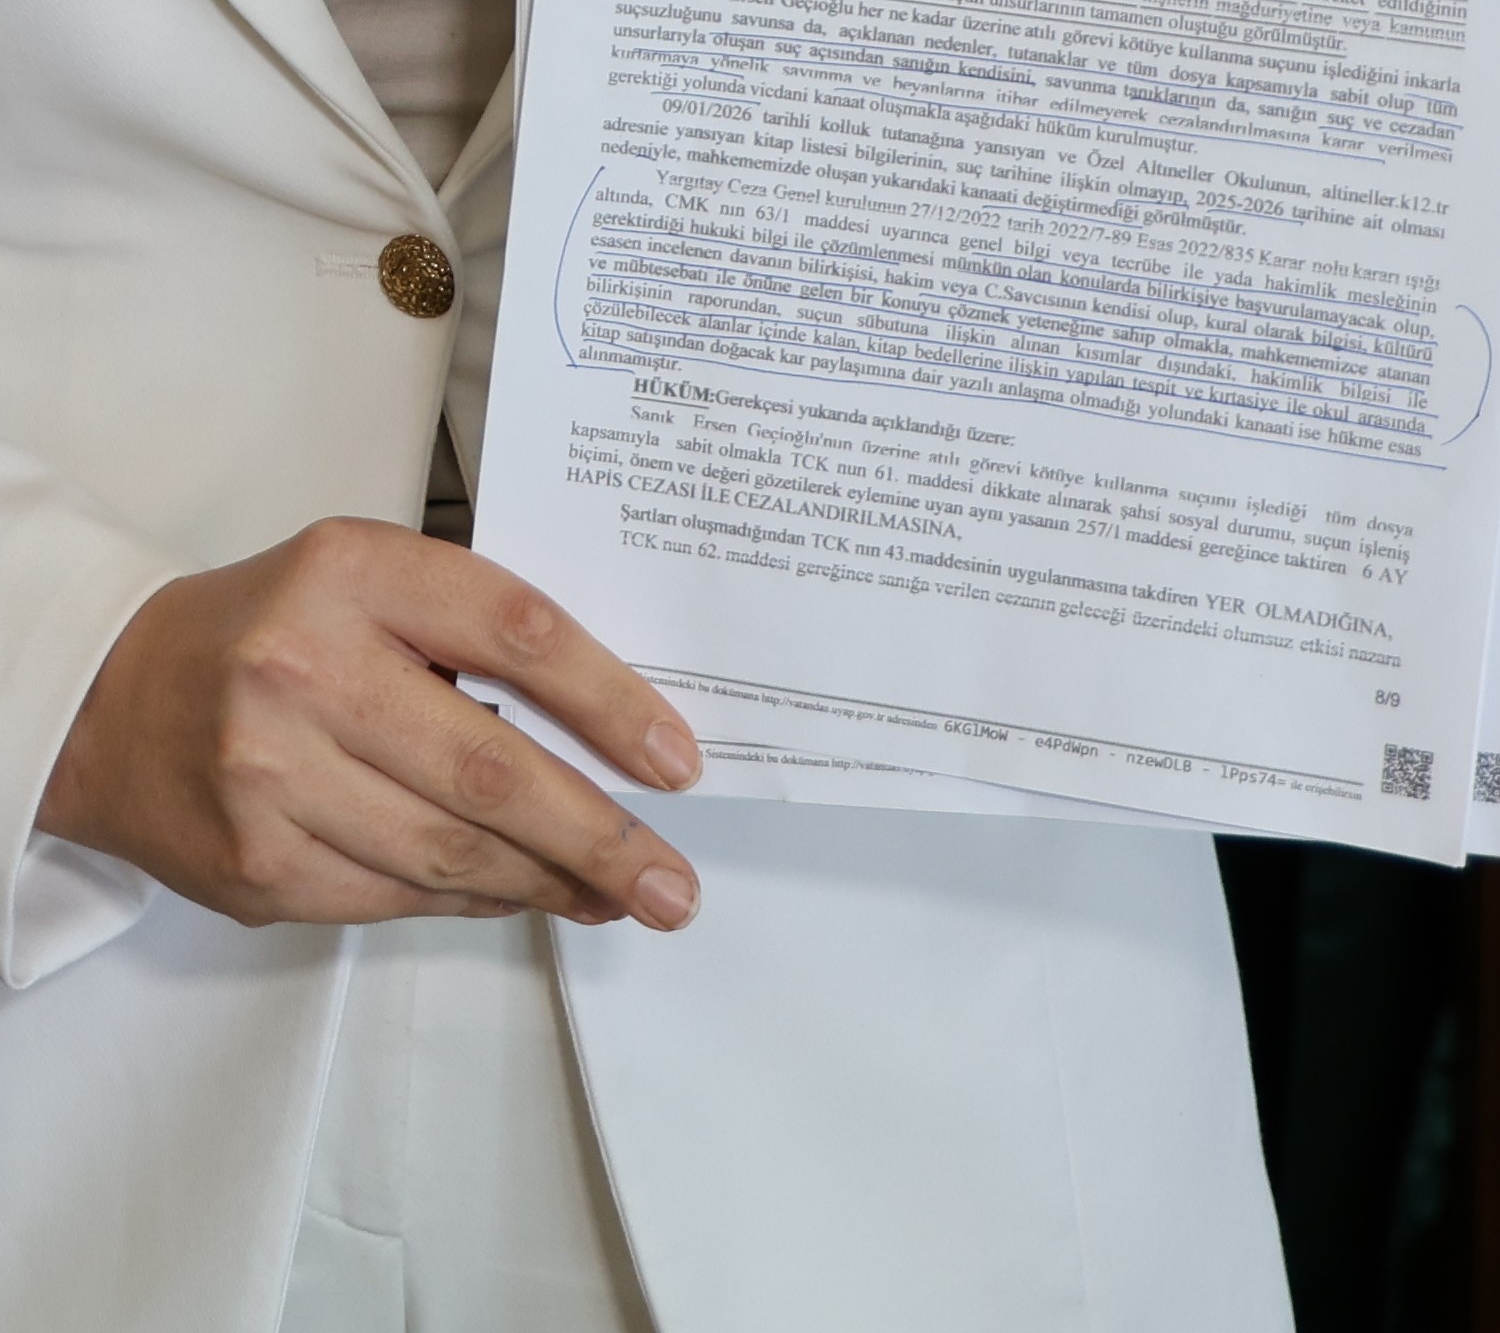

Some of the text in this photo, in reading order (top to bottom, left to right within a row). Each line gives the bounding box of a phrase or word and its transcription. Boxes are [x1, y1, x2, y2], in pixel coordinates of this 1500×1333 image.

[661, 96, 812, 131] 09/01/2026 tarihli
[664, 193, 791, 225] CMK 63/1
[910, 201, 1002, 230] 27/12/2022
[1196, 190, 1286, 218] 2025-2026
[798, 399, 870, 429] yukarıda
[565, 466, 732, 506] HAPİS CEZASI İLE
[1132, 581, 1395, 642] takdiren YER OLMADIĞINA,
[1374, 689, 1402, 709] 8/9
